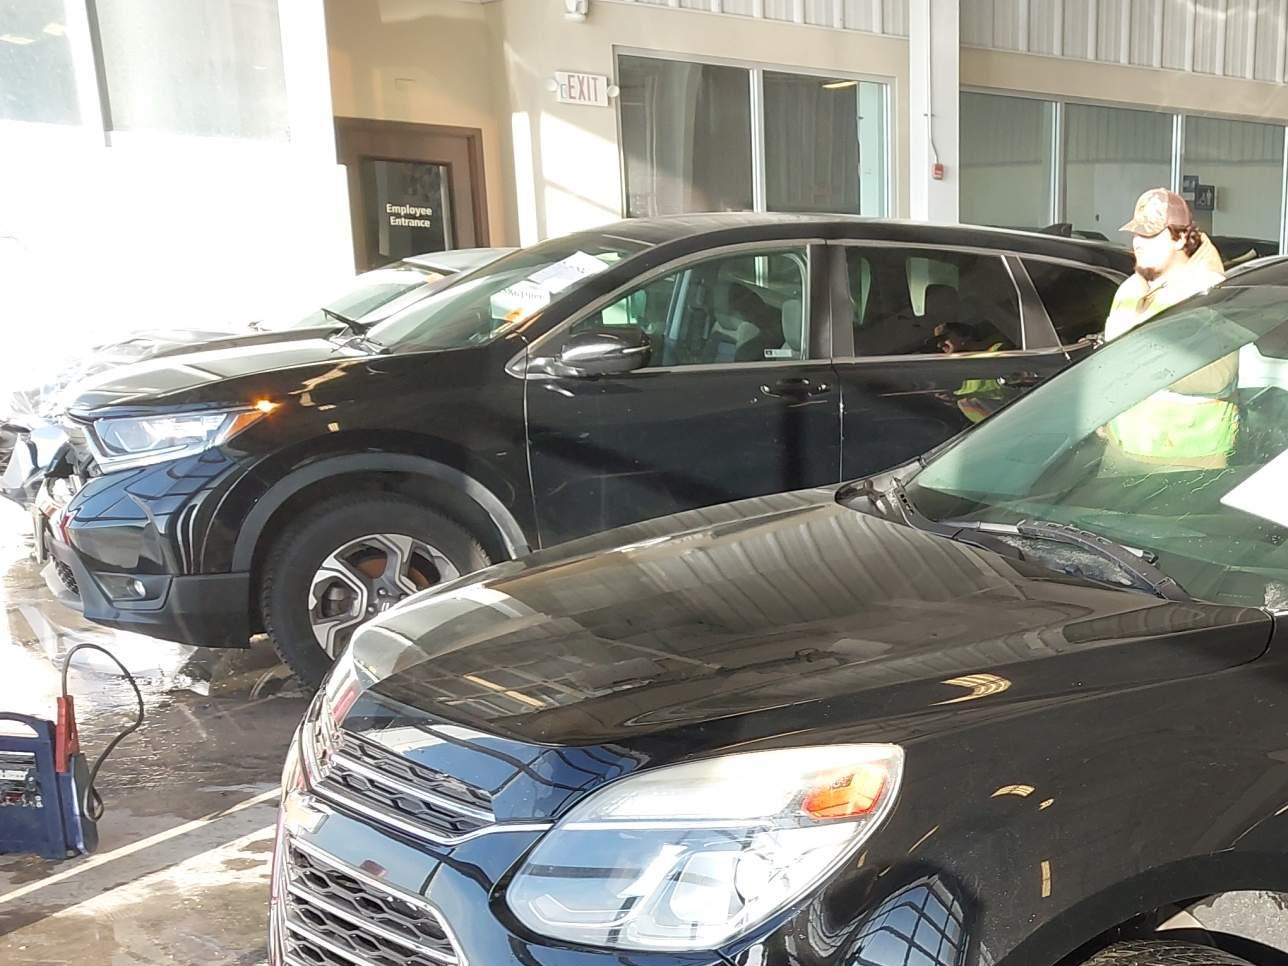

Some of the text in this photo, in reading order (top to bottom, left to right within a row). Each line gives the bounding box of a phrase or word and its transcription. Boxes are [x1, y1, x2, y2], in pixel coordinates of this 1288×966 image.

[567, 74, 599, 102] EXIT
[386, 203, 433, 217] Employee
[390, 215, 431, 228] Entrance
